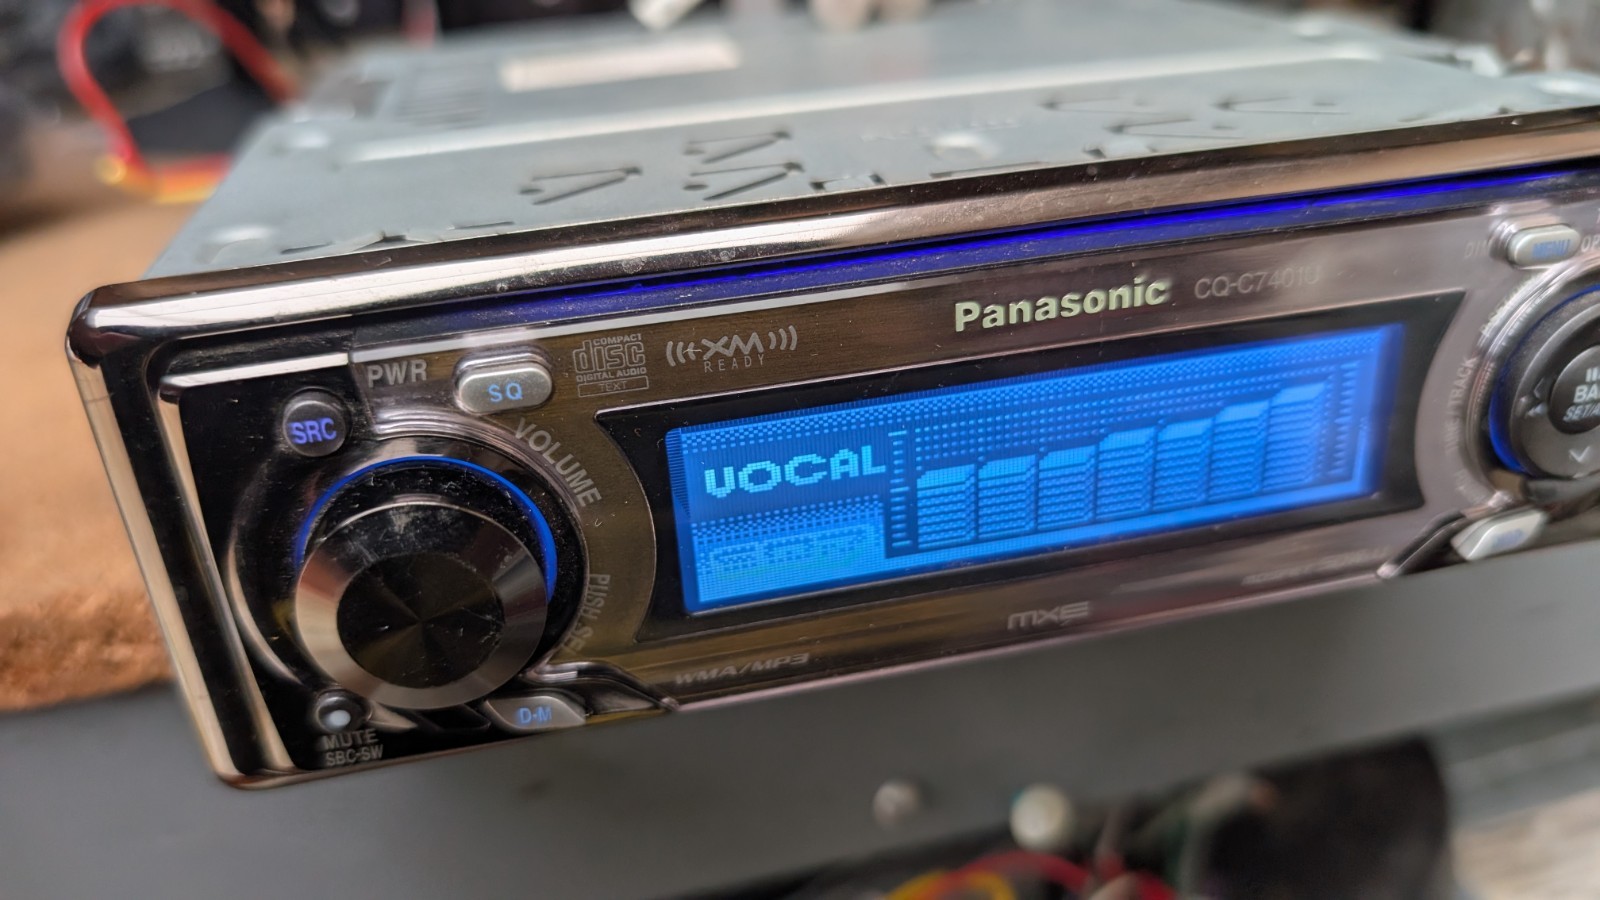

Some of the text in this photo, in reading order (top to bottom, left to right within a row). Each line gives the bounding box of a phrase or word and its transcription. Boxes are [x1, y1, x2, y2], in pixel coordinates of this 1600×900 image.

[1194, 265, 1322, 299] CQ-C7401U
[954, 275, 1171, 332] Panasonic
[593, 333, 642, 346] COMPACT
[701, 332, 764, 361] XM
[366, 359, 428, 387] PWR
[576, 367, 647, 383] DIGITAL AUDIO
[703, 354, 764, 373] READY
[488, 382, 523, 403] SQ
[598, 380, 628, 392] TEXT
[290, 417, 337, 445] SRC
[515, 417, 602, 507] VOLUME
[704, 445, 886, 498] VOCAL
[581, 573, 611, 620] PUSH
[674, 653, 810, 684] WMA/MP3
[323, 728, 379, 750] MUTE
[325, 744, 384, 767] SBC-SW
